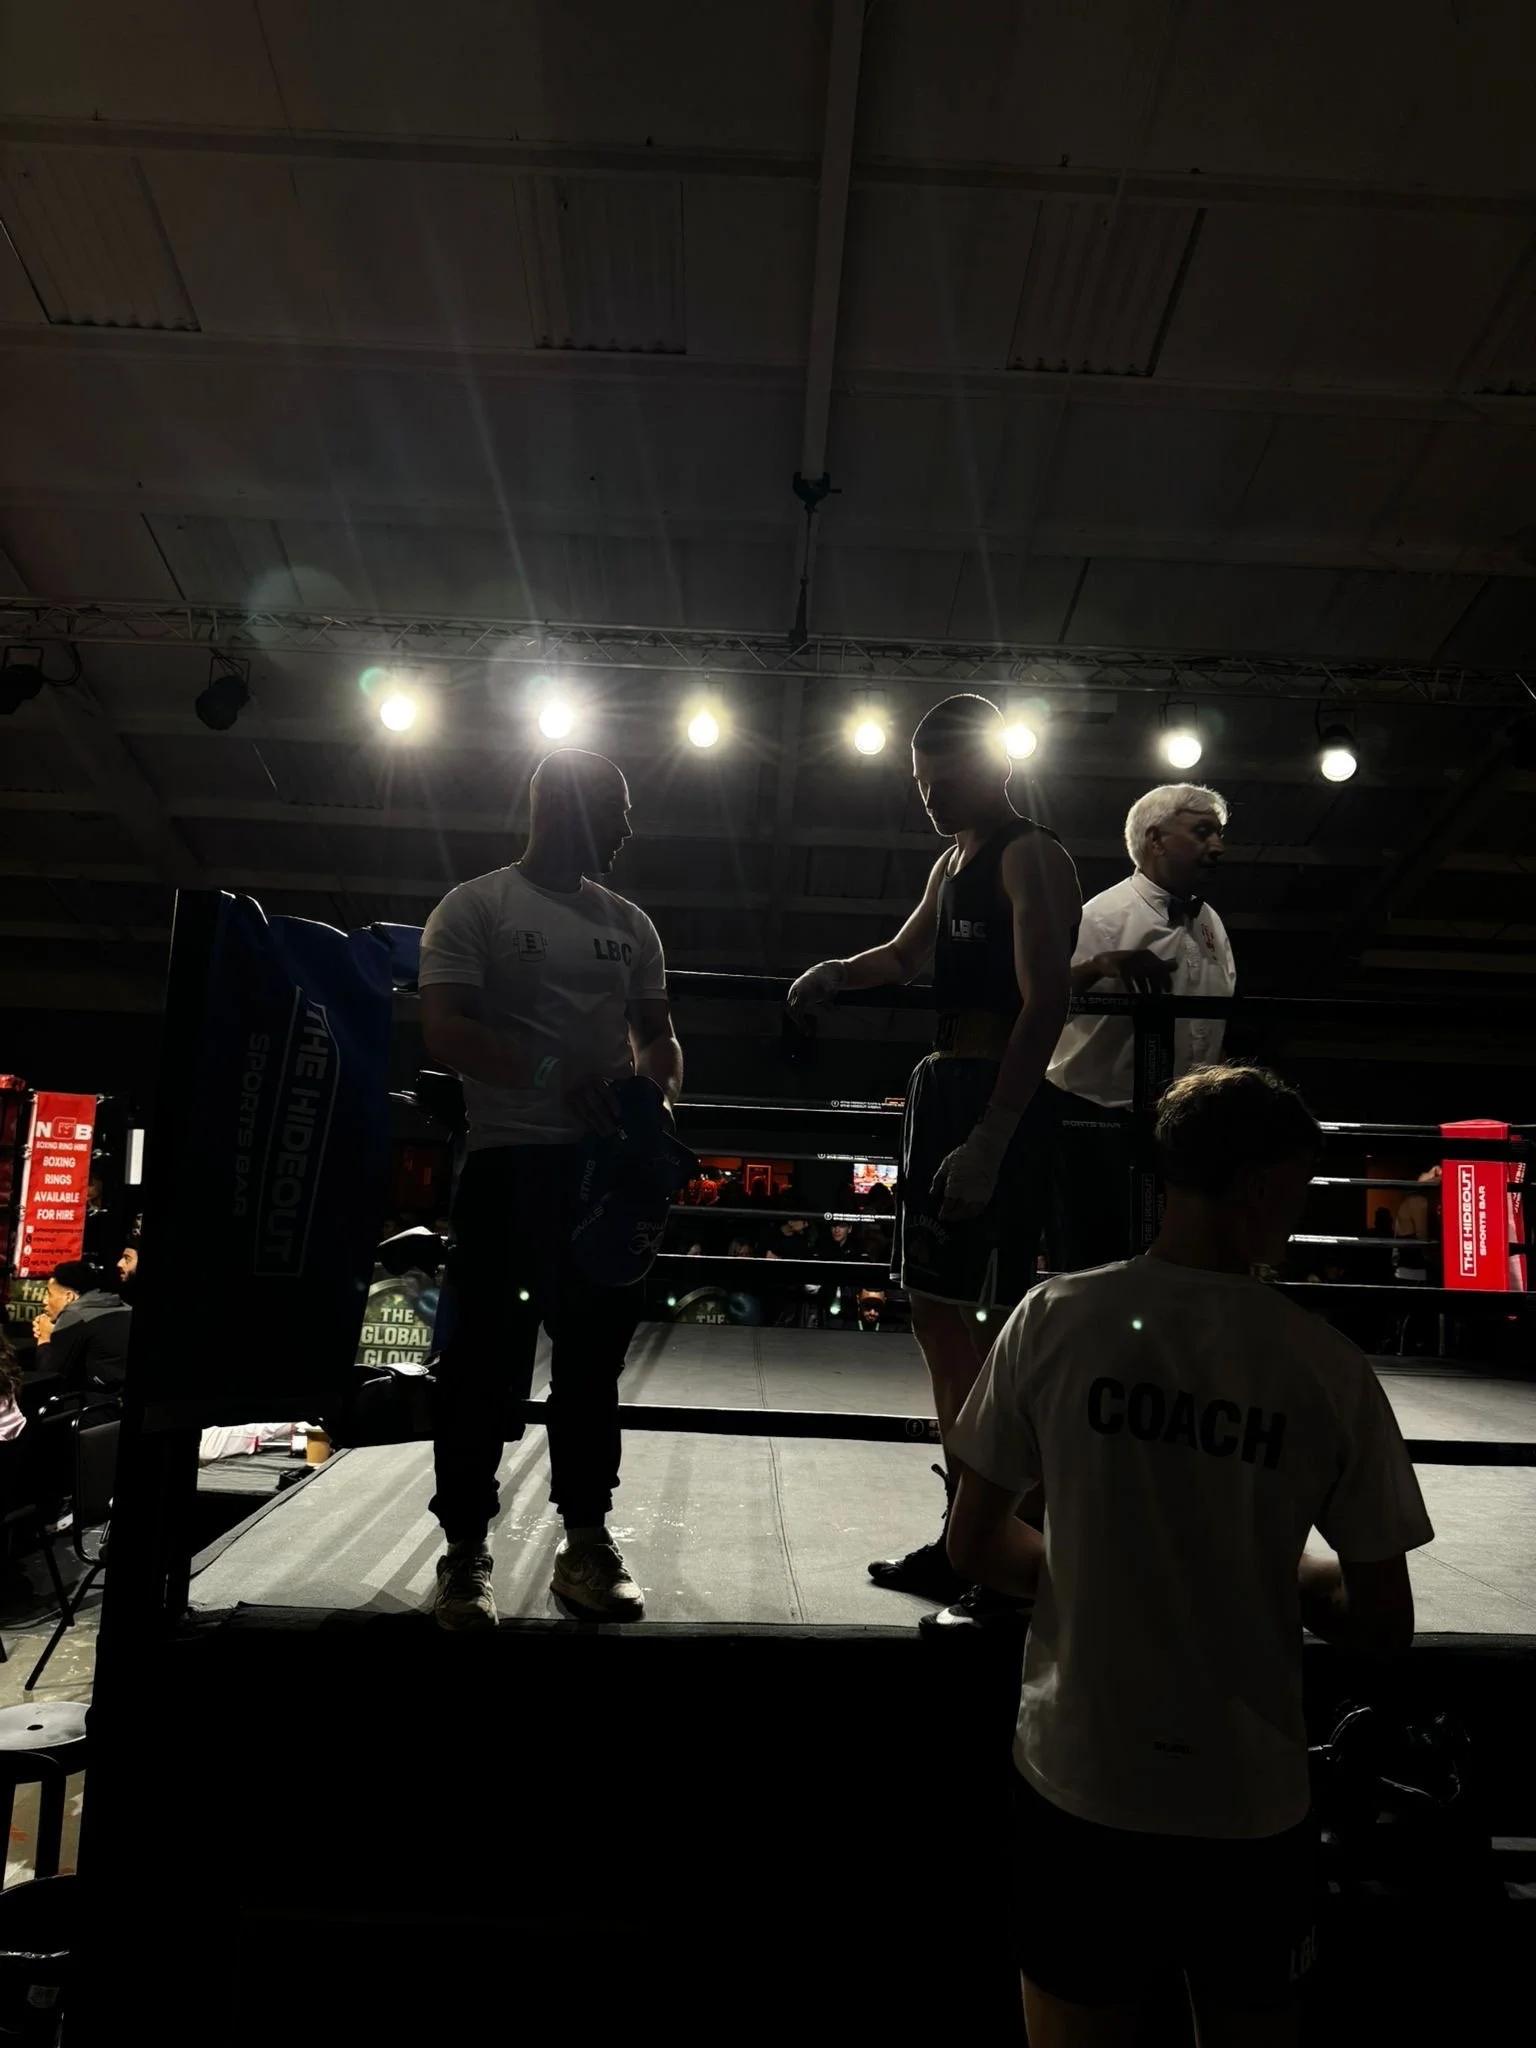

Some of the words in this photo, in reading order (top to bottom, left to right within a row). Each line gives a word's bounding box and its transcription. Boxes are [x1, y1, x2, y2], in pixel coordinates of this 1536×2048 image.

[952, 919, 988, 939] LBC
[593, 938, 633, 967] LBC
[236, 1031, 272, 1150] SPORTS
[1061, 1119, 1097, 1129] PORTS
[43, 1156, 76, 1168] BOXING
[44, 1173, 73, 1185] RINGS
[263, 1086, 322, 1264] HIDEOUT
[230, 1153, 252, 1219] BAR
[34, 1191, 80, 1204] AVAILABLE
[1461, 1170, 1474, 1239] HIDEOUT
[1478, 1185, 1487, 1210] BAR
[36, 1208, 55, 1220] FOR
[55, 1209, 75, 1221] HIRE
[1478, 1210, 1488, 1257] SPORTS
[1463, 1241, 1474, 1272] THE
[21, 1283, 45, 1302] TH
[380, 1307, 415, 1323] THE
[360, 1325, 432, 1346] GLOBAL
[363, 1349, 424, 1367] GLOVE
[1087, 1377, 1287, 1470] COACH
